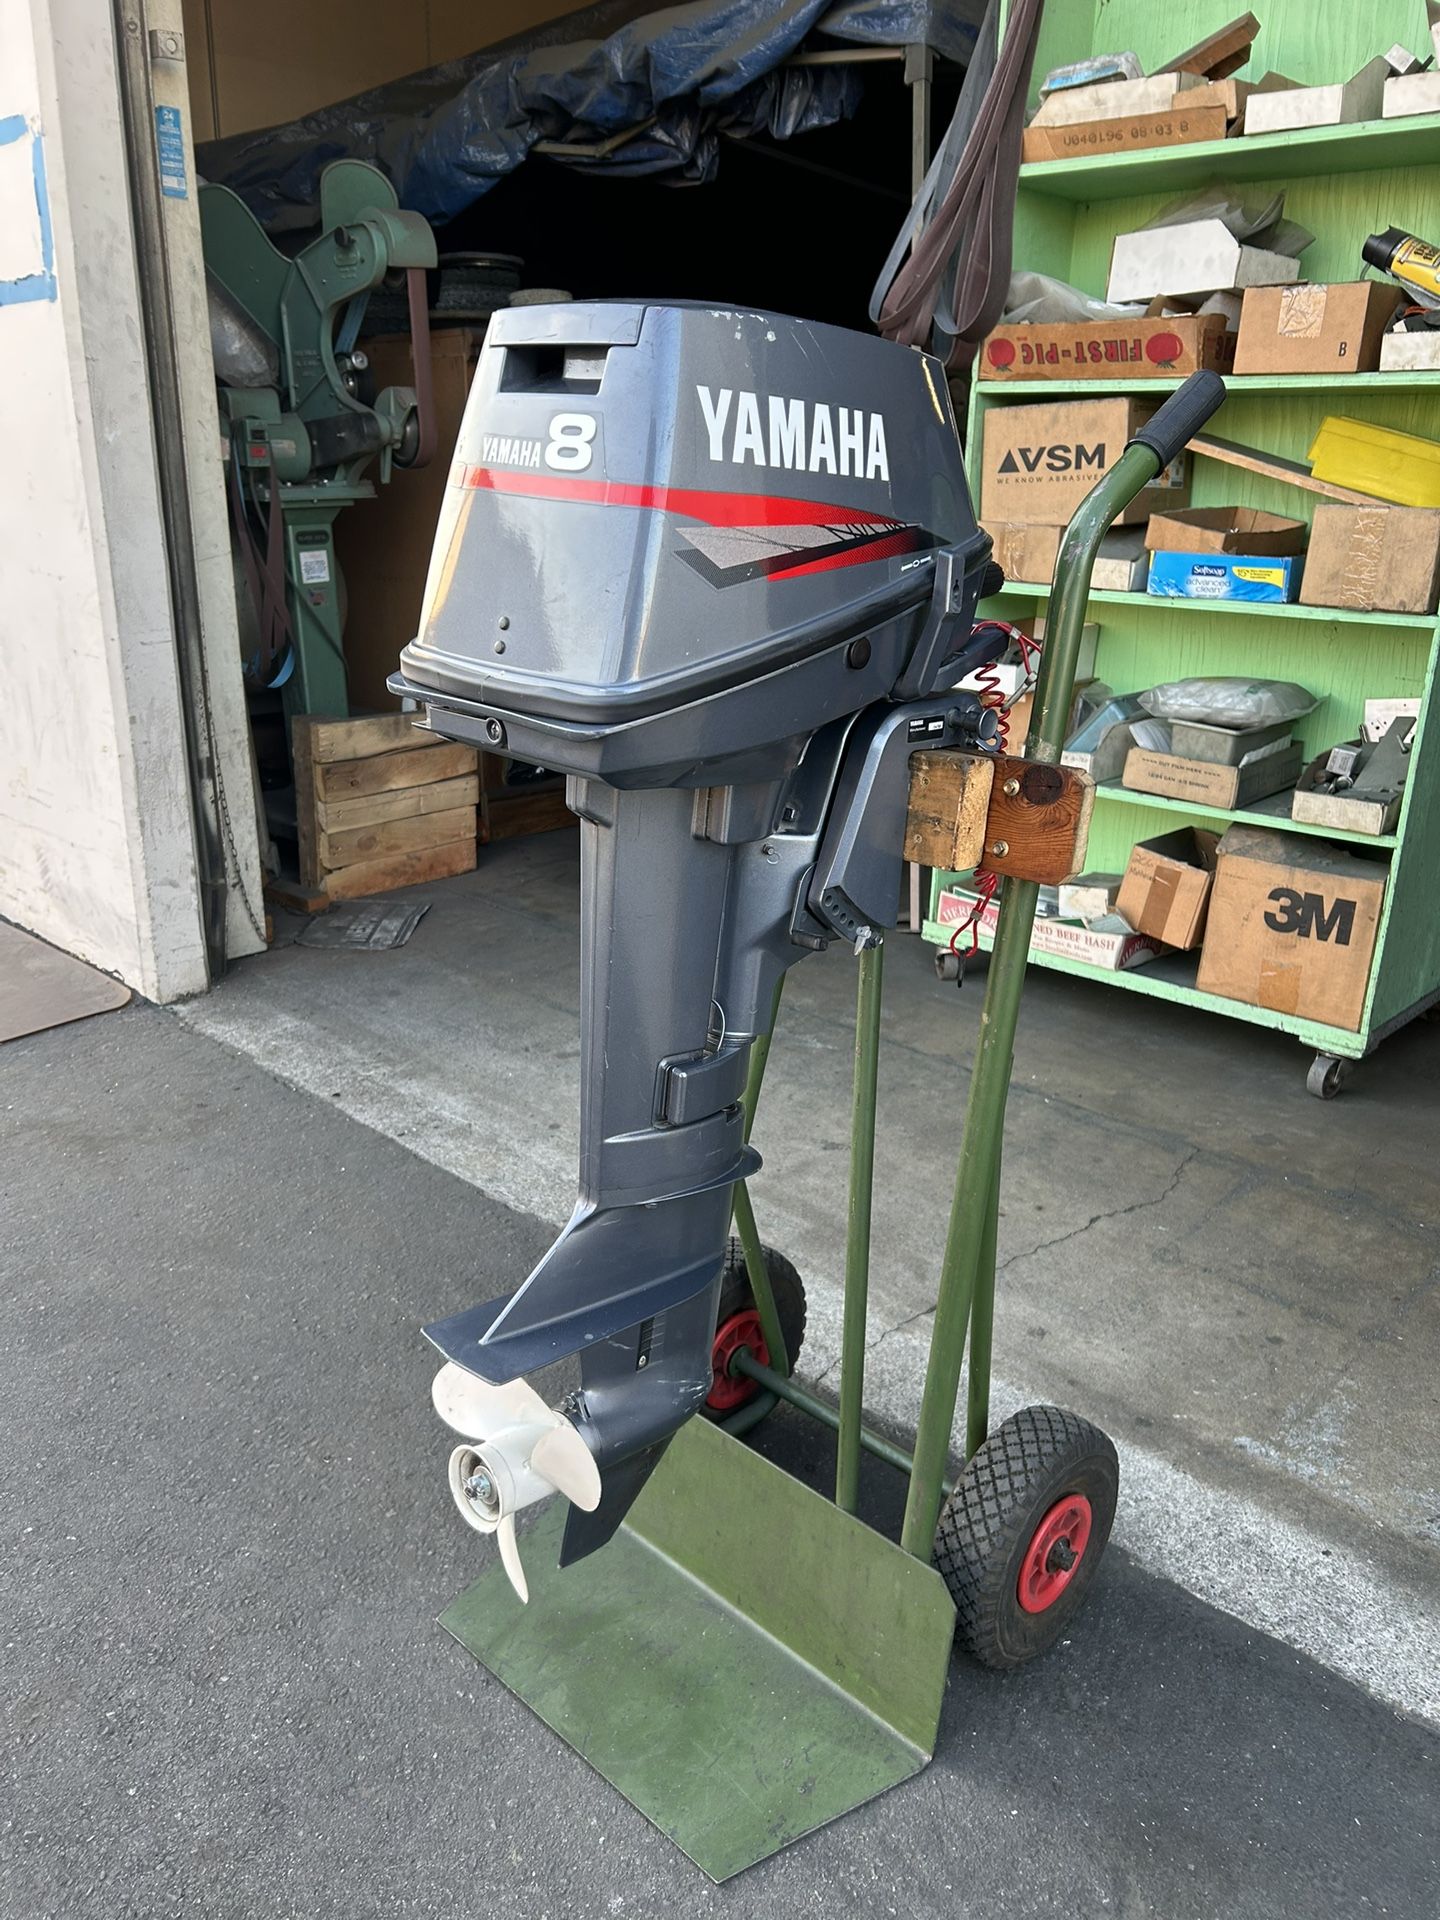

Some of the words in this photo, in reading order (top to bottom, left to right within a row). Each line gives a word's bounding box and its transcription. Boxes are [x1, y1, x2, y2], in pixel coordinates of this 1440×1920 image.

[1338, 341, 1347, 357] B
[482, 437, 541, 468] YAMAHA
[544, 413, 597, 471] 8
[696, 385, 890, 481] YAMAHA
[1018, 443, 1106, 472] VSM
[1015, 476, 1043, 484] KNOW
[1264, 887, 1357, 946] 3M
[1056, 928, 1081, 942] BEEF
[1085, 935, 1115, 951] HASH
